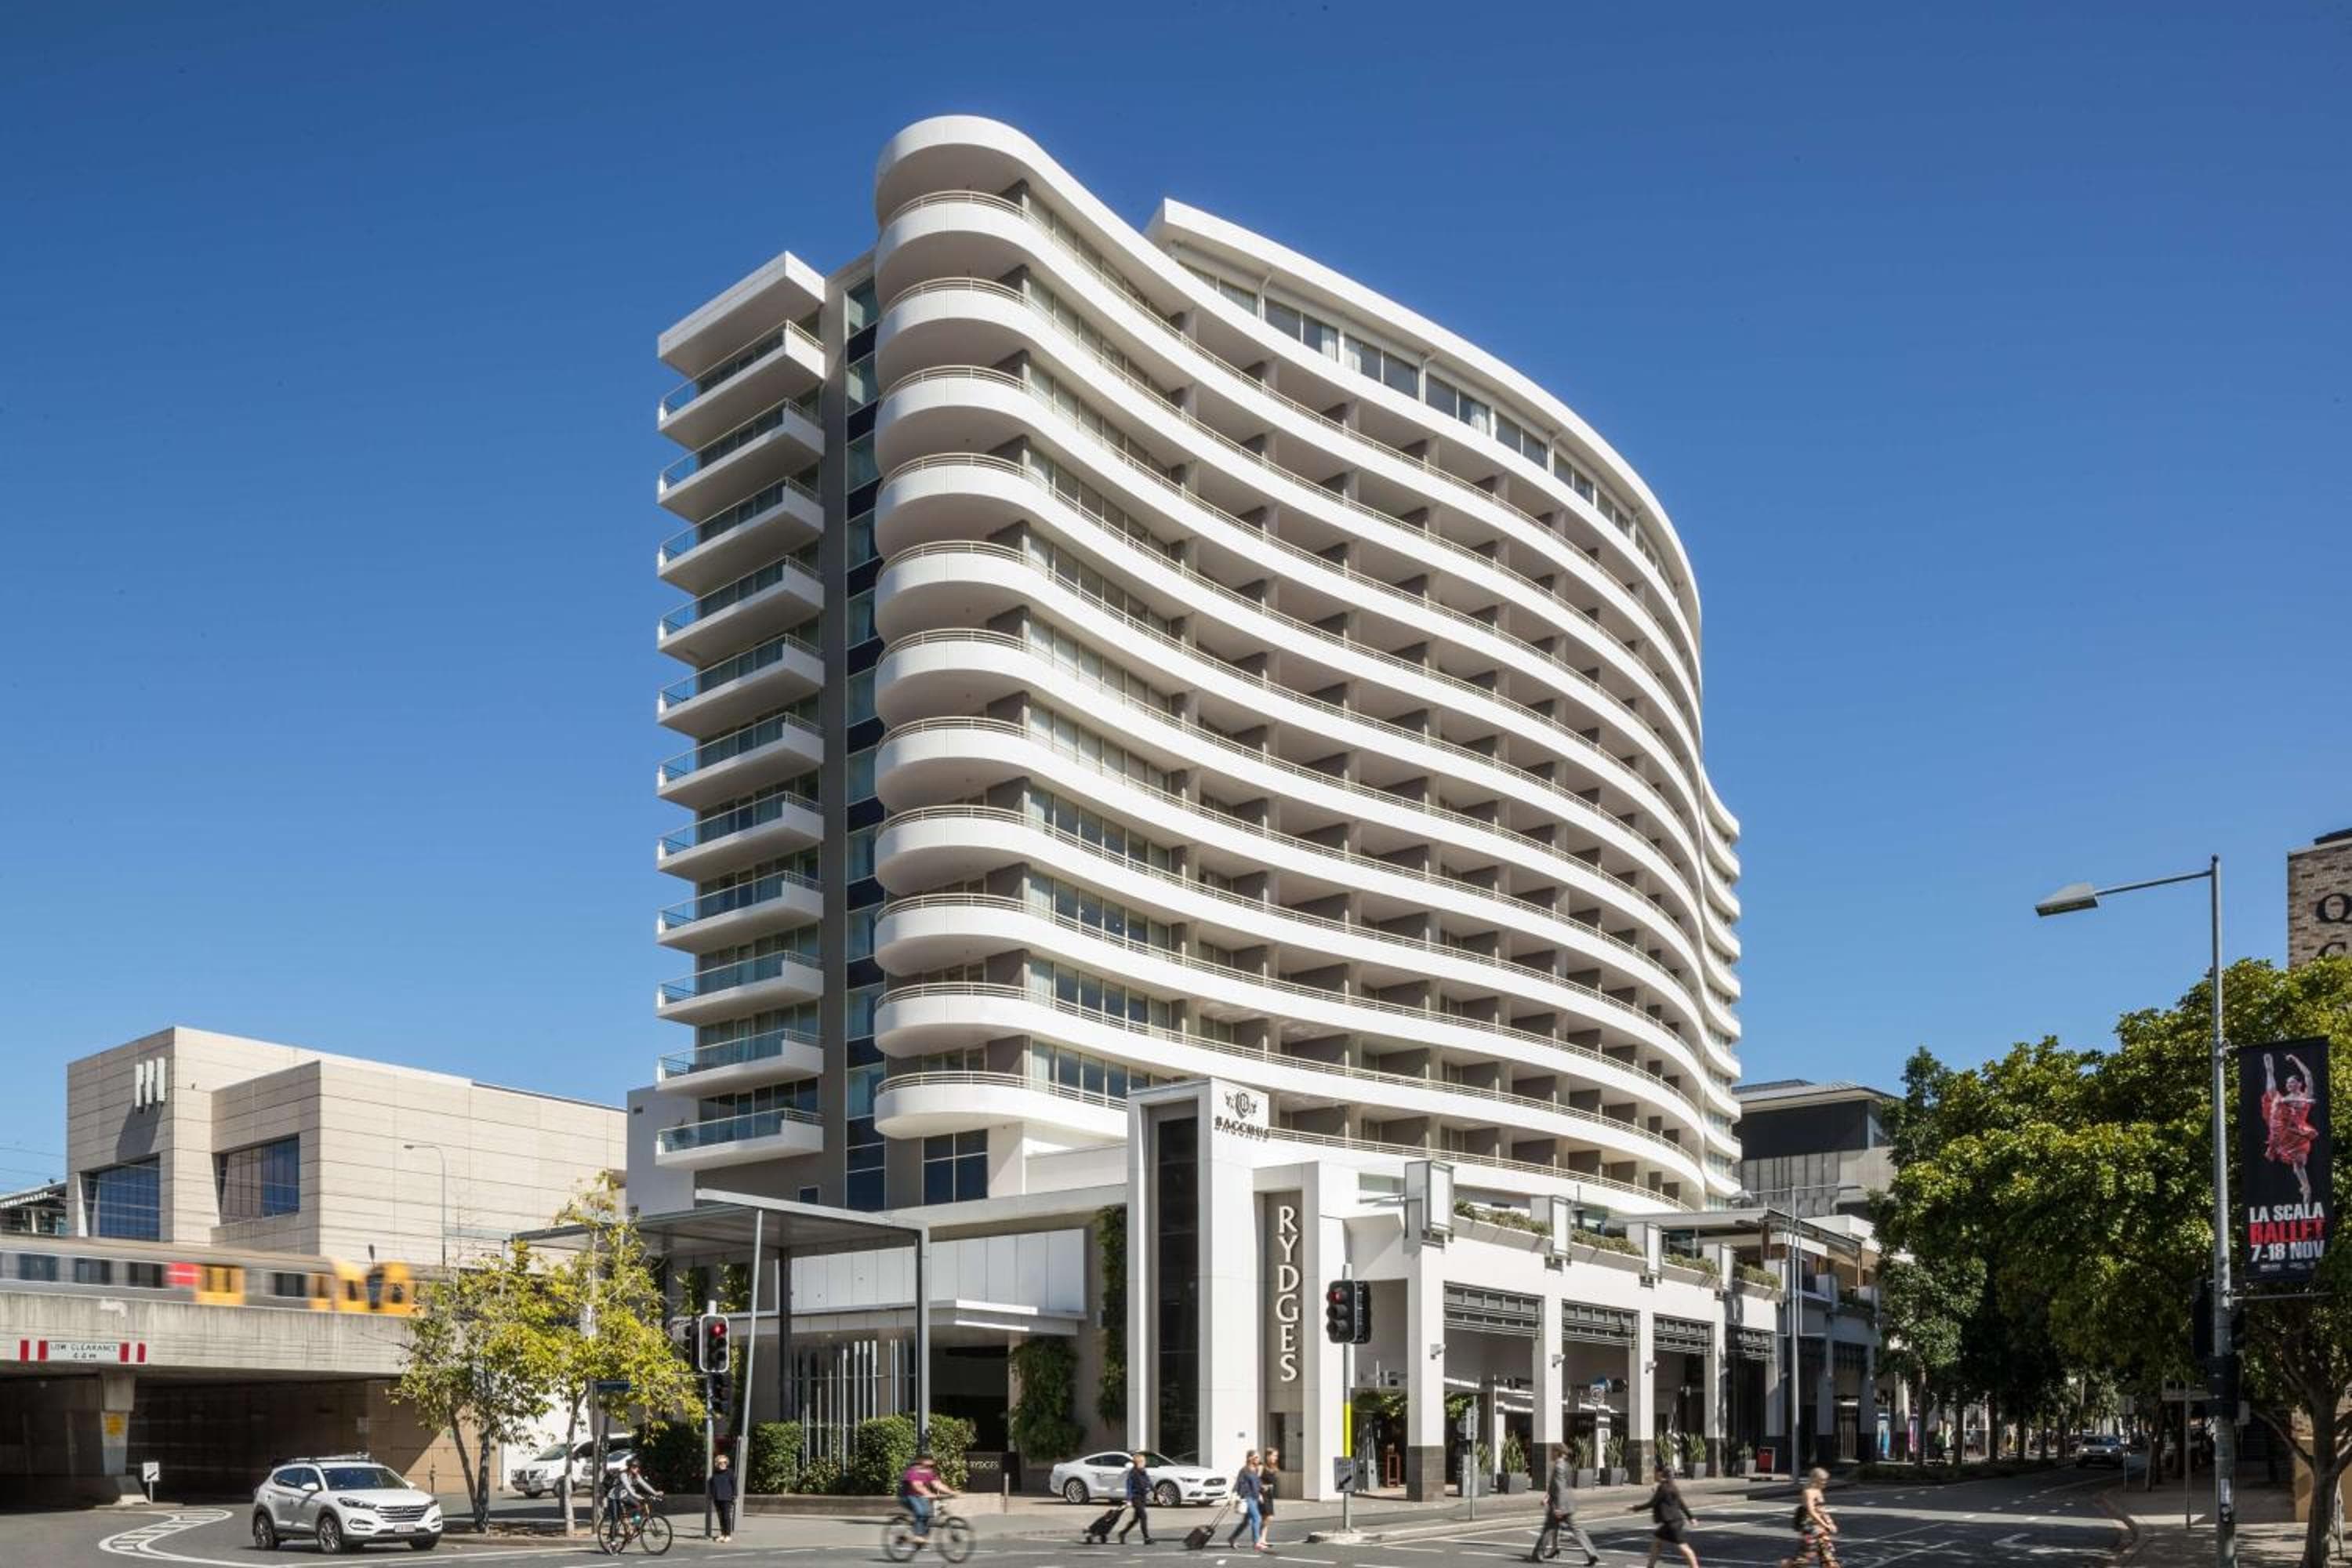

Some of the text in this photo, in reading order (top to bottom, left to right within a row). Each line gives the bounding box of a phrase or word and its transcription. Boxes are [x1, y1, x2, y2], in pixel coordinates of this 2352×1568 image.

[1215, 1116, 1270, 1139] BACCHUS
[2249, 1202, 2325, 1223] LA SCALA
[2249, 1218, 2326, 1245] BALLET
[2250, 1240, 2325, 1262] 7-18 NOV
[1276, 1205, 1300, 1382] RYDGES
